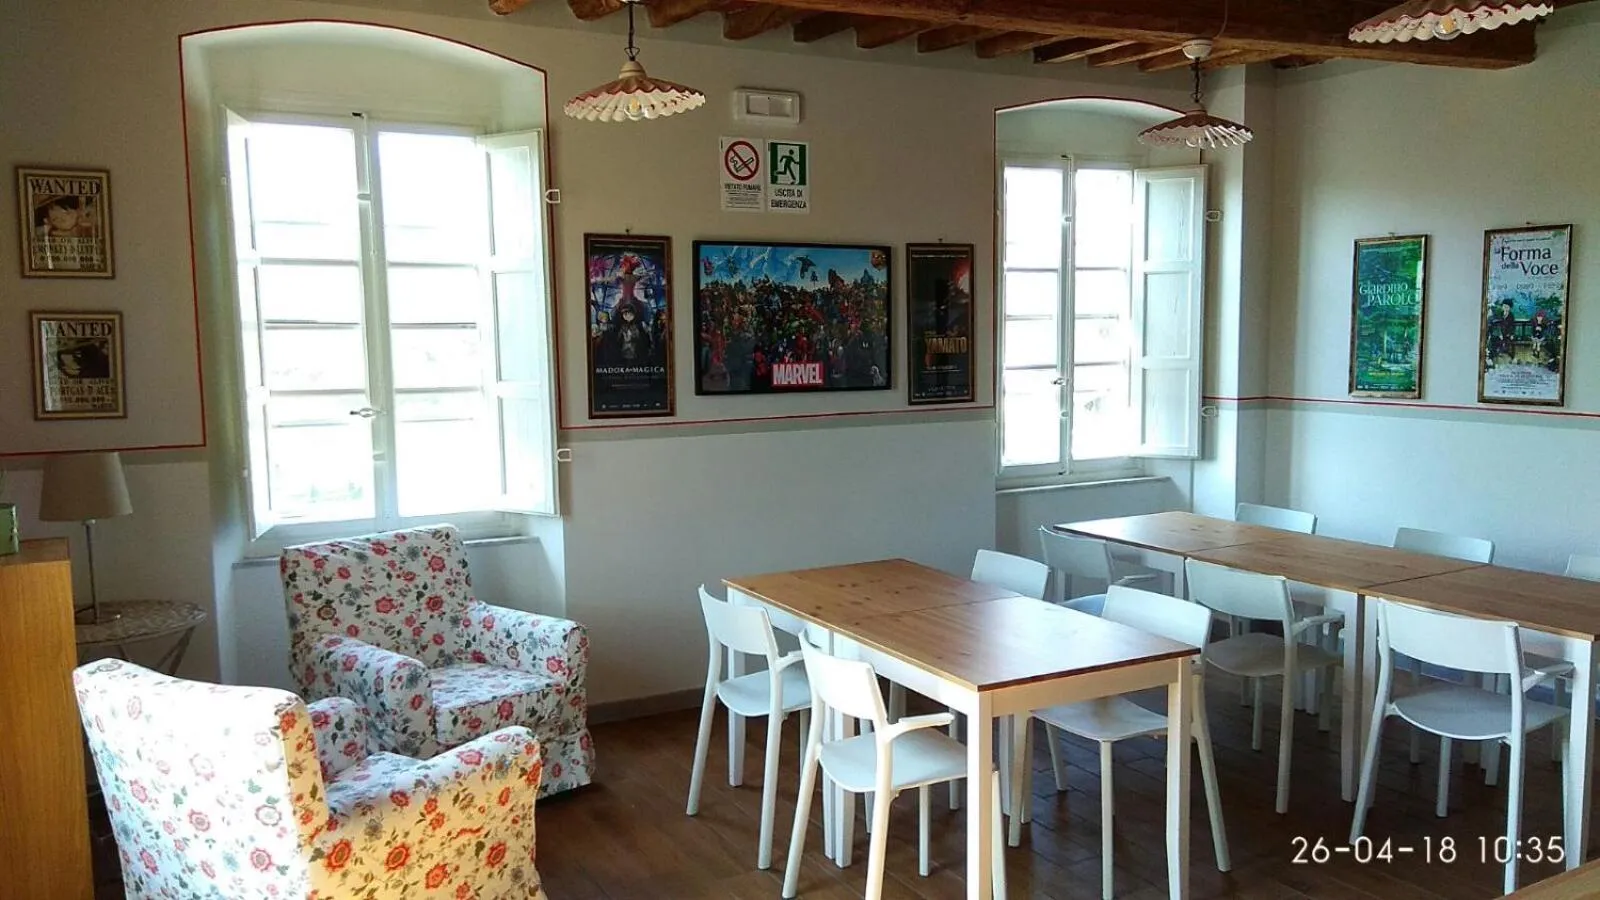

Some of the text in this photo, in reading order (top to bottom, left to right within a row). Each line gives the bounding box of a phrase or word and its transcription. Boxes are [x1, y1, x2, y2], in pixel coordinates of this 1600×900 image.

[30, 179, 102, 195] WANTED
[774, 188, 803, 198] USCITA DI
[770, 199, 807, 208] EMERGENZA
[1501, 245, 1552, 261] Forma
[1519, 260, 1559, 276] Voce
[44, 321, 113, 337] WANTED
[772, 362, 823, 385] MARVEL
